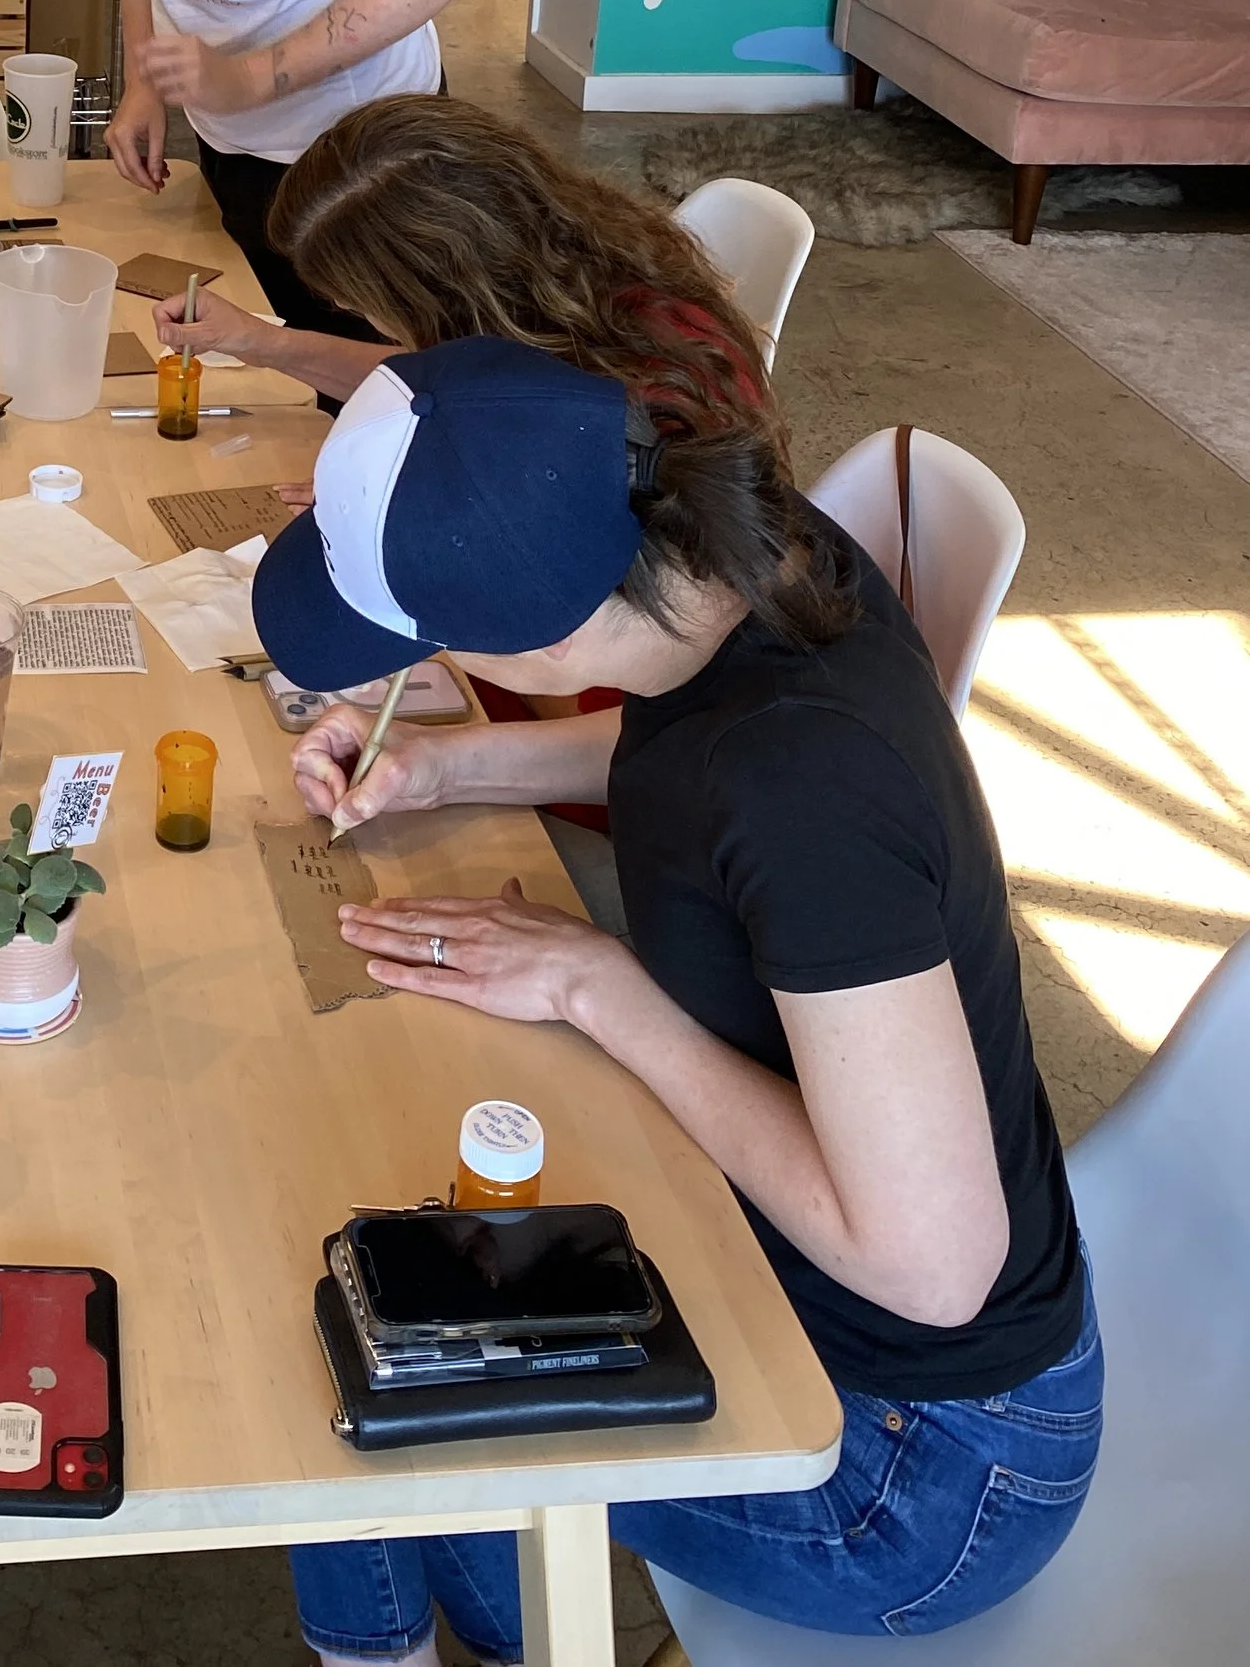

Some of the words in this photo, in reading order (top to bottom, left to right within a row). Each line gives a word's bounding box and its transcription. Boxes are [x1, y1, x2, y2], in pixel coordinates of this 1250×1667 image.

[72, 760, 114, 780] Menu
[87, 783, 111, 828] Beer
[480, 1108, 503, 1124] DOWN
[509, 1128, 530, 1145] THEN
[486, 1122, 508, 1139] TURN
[501, 1113, 524, 1130] PUSH
[531, 1357, 561, 1370] PIGMENT
[562, 1354, 600, 1368] FINELINERS
